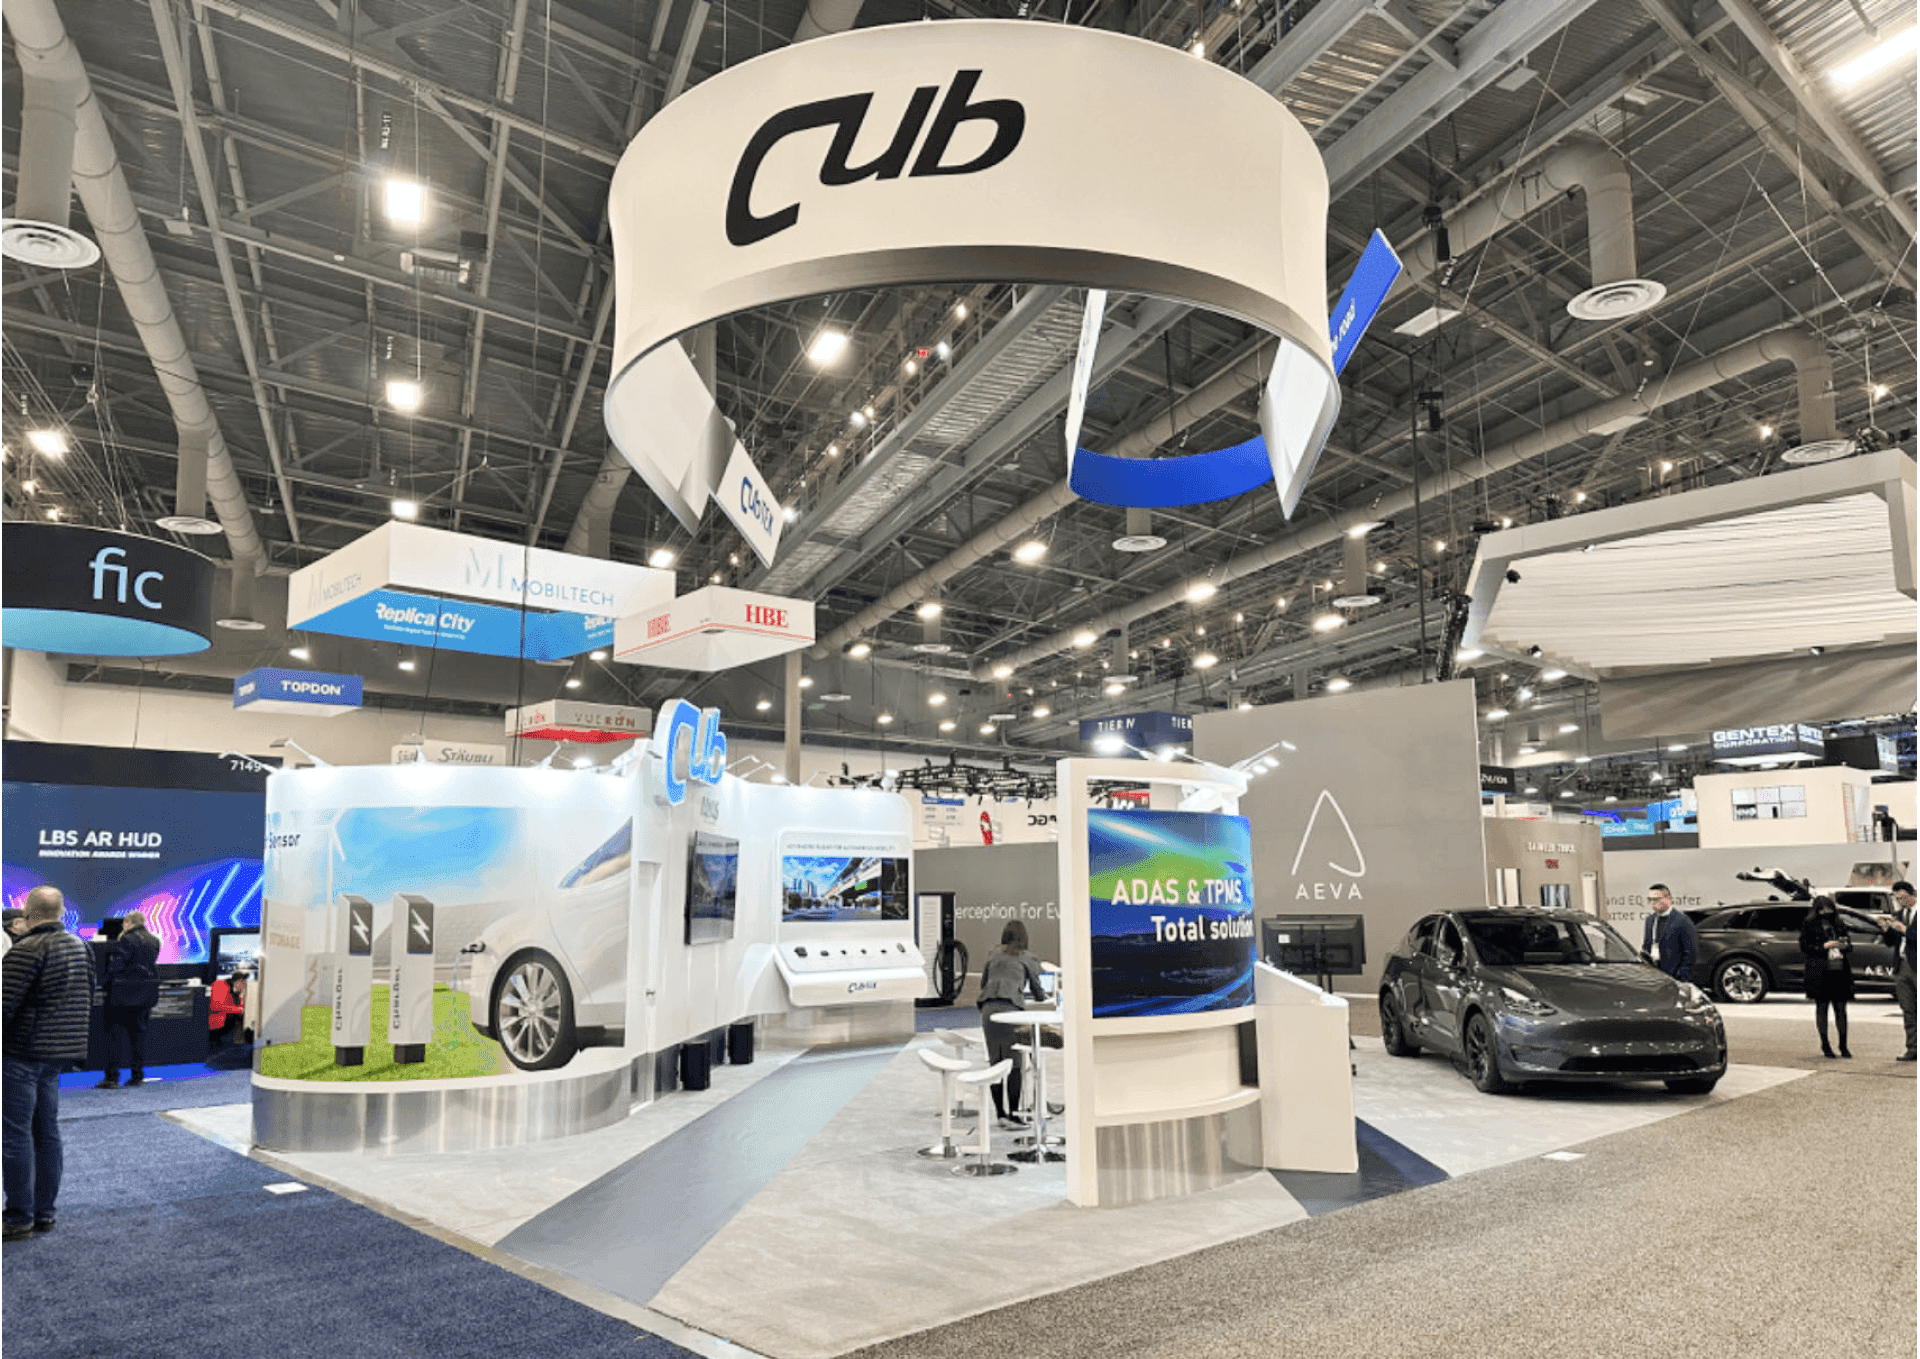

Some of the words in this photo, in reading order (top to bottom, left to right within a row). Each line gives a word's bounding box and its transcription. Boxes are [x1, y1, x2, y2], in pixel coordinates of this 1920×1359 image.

[726, 70, 1025, 246] Cub
[89, 546, 164, 610] fic
[511, 577, 614, 607] MOBILTECH
[376, 603, 436, 626] Replica
[440, 613, 476, 633] City
[744, 603, 789, 629] HBE
[281, 680, 341, 696] TOPDON
[1713, 724, 1796, 742] GENTEX
[39, 829, 79, 846] LBS
[83, 831, 113, 847] AR
[118, 832, 162, 847] HUD
[1111, 878, 1180, 905] ADAS
[1187, 878, 1200, 905] &
[1204, 878, 1242, 904] TPMS
[1295, 882, 1363, 900] AEVA
[955, 903, 1017, 922] erception
[1020, 902, 1043, 919] For
[1151, 915, 1206, 942] Total
[1865, 965, 1894, 976] AEV
